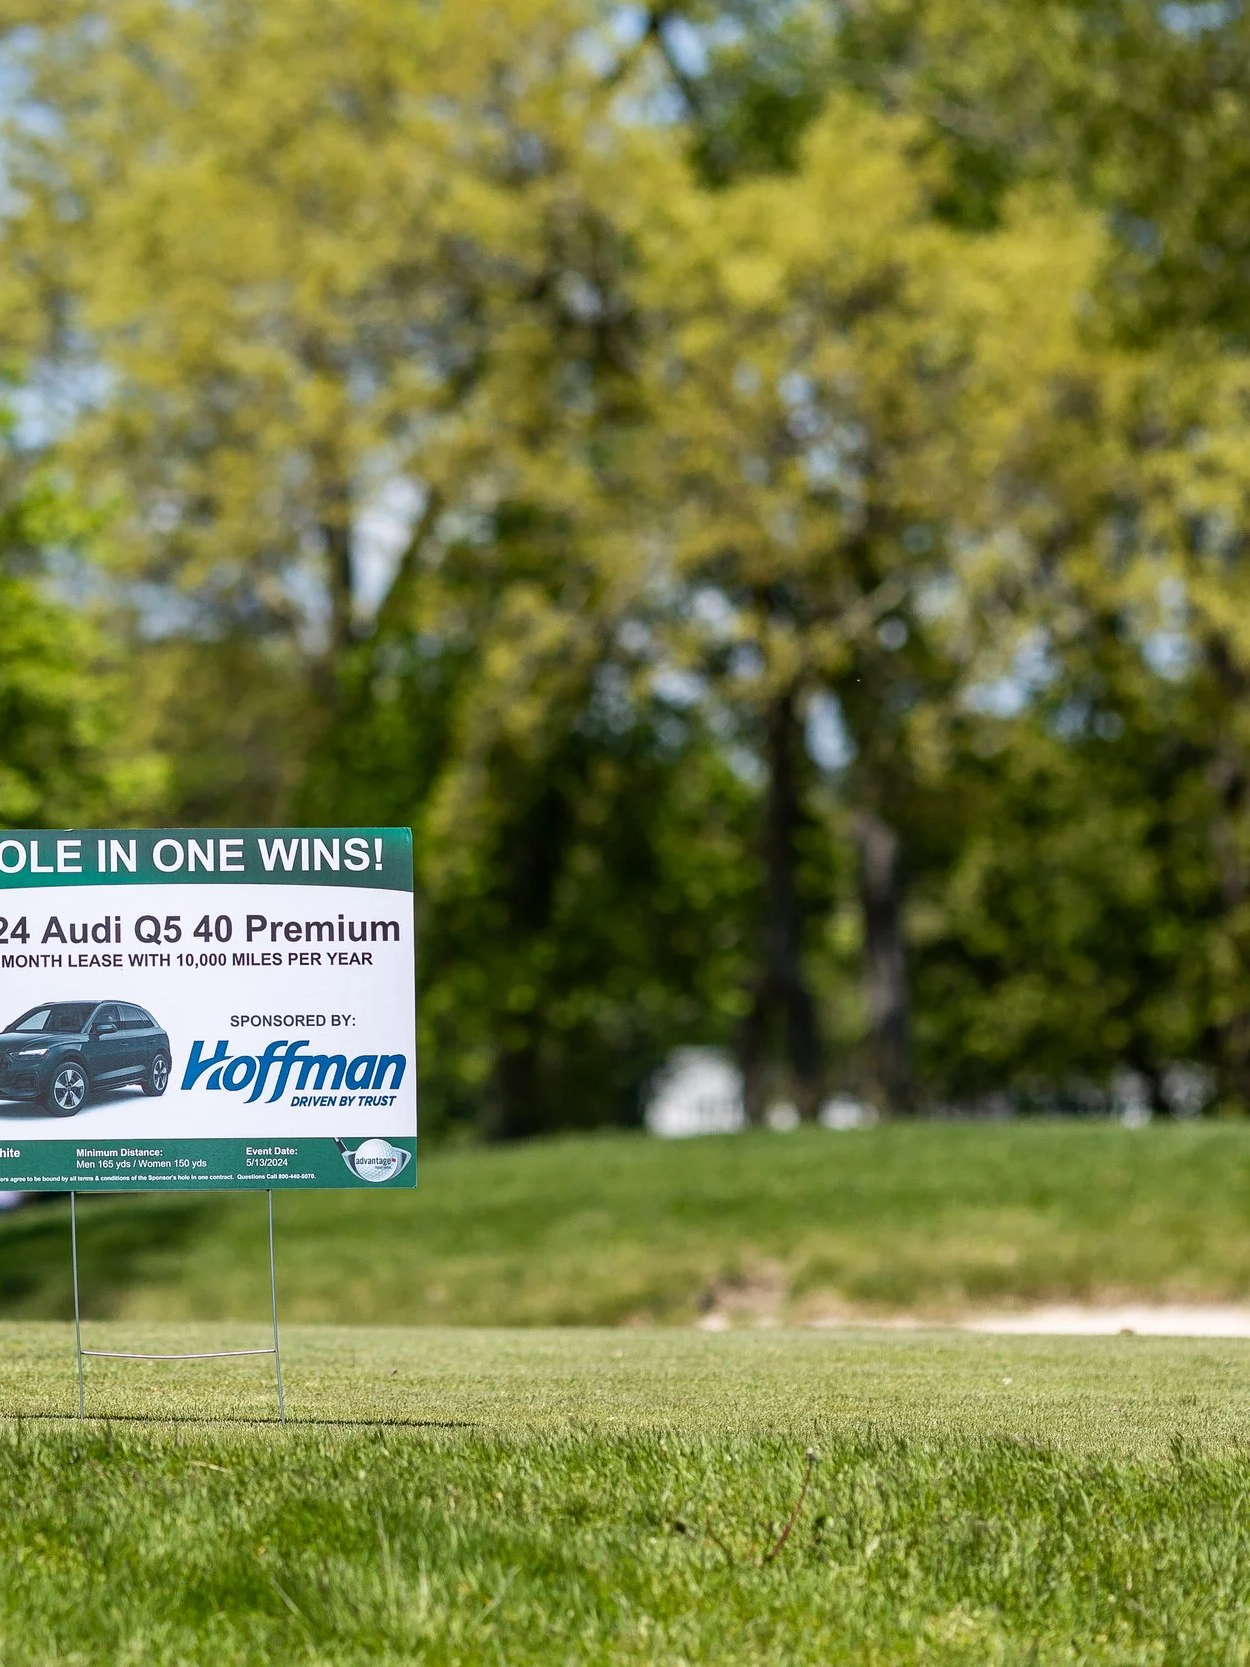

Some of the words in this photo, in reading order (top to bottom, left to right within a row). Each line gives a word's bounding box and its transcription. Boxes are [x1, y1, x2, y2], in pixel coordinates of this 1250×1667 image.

[98, 840, 136, 872] IN
[153, 839, 244, 872] ONE
[258, 838, 382, 871] WINS!
[41, 916, 121, 943] Audi
[135, 915, 181, 945] Q5
[194, 915, 232, 942] 40
[247, 914, 399, 942] Premium
[2, 955, 61, 968] MONTH
[69, 954, 123, 967] LEASE
[128, 954, 170, 966] WITH
[177, 953, 226, 968] 10,000
[233, 953, 282, 966] MILES
[289, 953, 321, 965] PER
[327, 953, 372, 965] YEAR
[231, 1015, 326, 1027] SPONSORED
[332, 1015, 355, 1026] BY:
[181, 1040, 407, 1103] Hoffman
[291, 1096, 338, 1107] DRIVEN
[340, 1096, 355, 1107] BY
[358, 1096, 397, 1107] TRUST
[76, 1149, 118, 1157] Minimum
[121, 1148, 163, 1157] Distance:
[246, 1147, 272, 1155] Event
[275, 1147, 298, 1155] Date:
[76, 1160, 95, 1169] Men
[98, 1160, 114, 1168] 165
[116, 1160, 131, 1170] yds
[133, 1160, 136, 1168] /
[138, 1159, 171, 1168] Women
[174, 1159, 190, 1167] 150
[191, 1159, 207, 1169] yds
[246, 1158, 288, 1167] 5/13/2024
[355, 1157, 391, 1165] advantage
